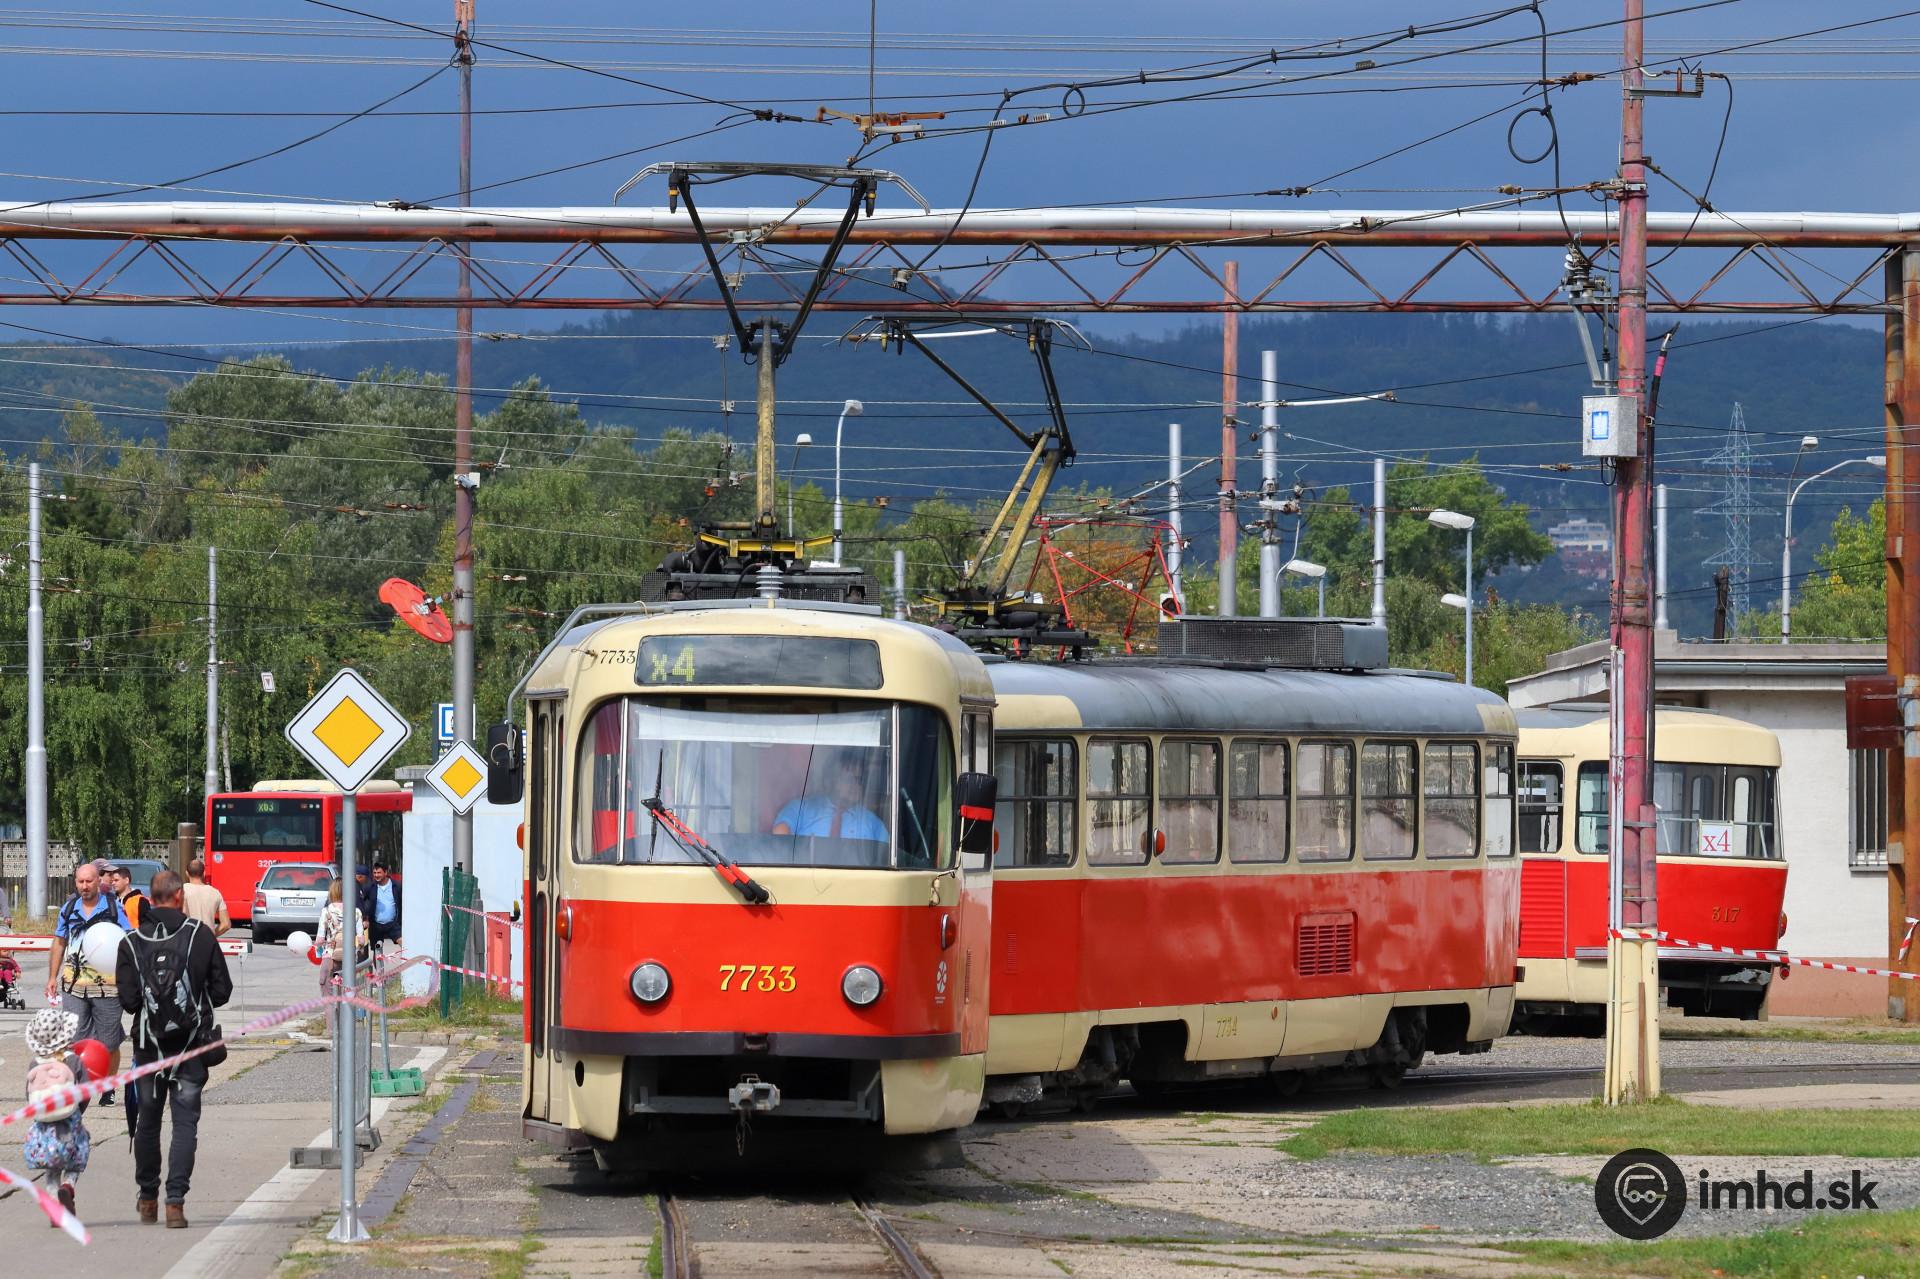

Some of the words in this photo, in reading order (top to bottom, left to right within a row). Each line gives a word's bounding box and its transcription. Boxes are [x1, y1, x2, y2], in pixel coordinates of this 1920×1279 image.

[600, 650, 636, 665] 7733
[1703, 829, 1731, 852] x4
[1711, 906, 1742, 923] 317
[719, 964, 798, 992] 7733
